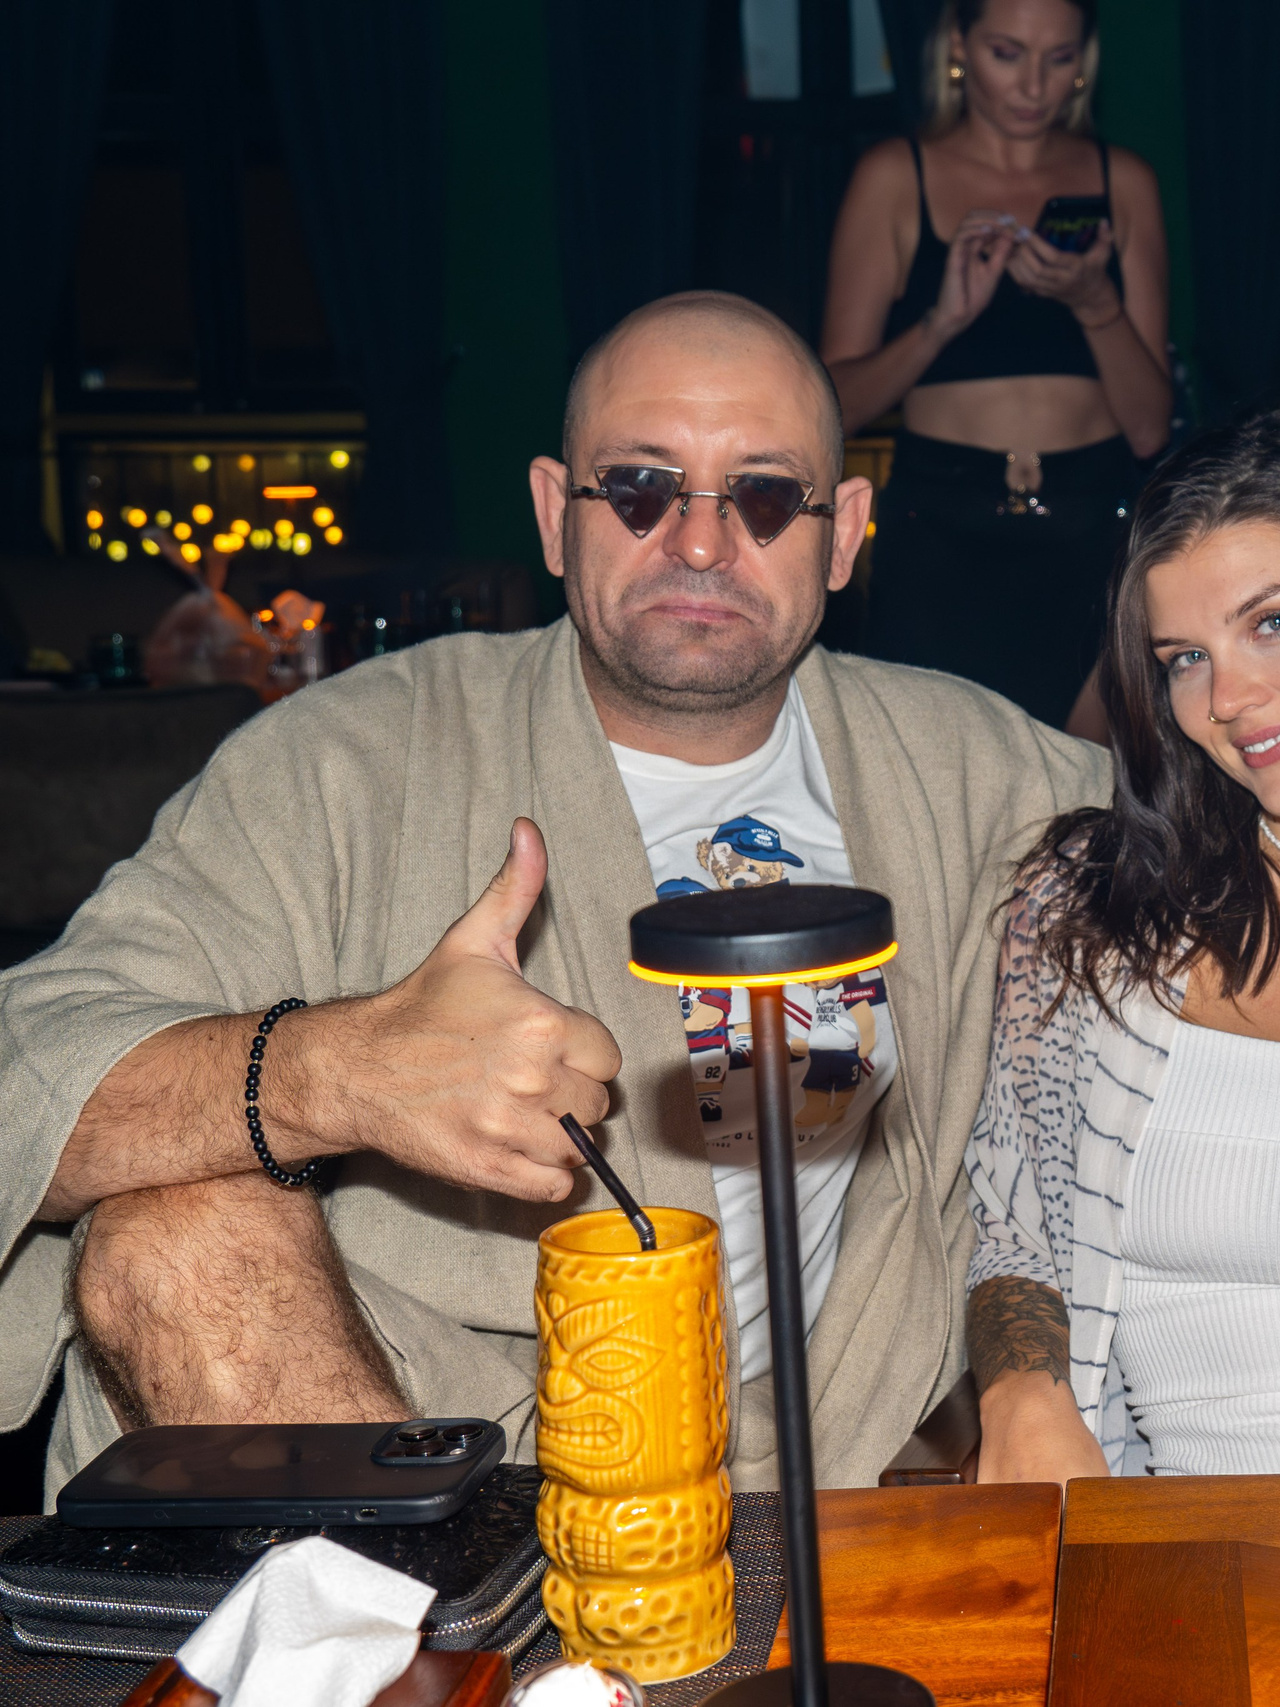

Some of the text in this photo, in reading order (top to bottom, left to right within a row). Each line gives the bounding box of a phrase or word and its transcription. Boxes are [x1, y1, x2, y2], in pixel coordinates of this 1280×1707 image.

[851, 989, 873, 998] ORIGINAL
[705, 1065, 721, 1079] 82
[851, 1064, 859, 1081] 3
